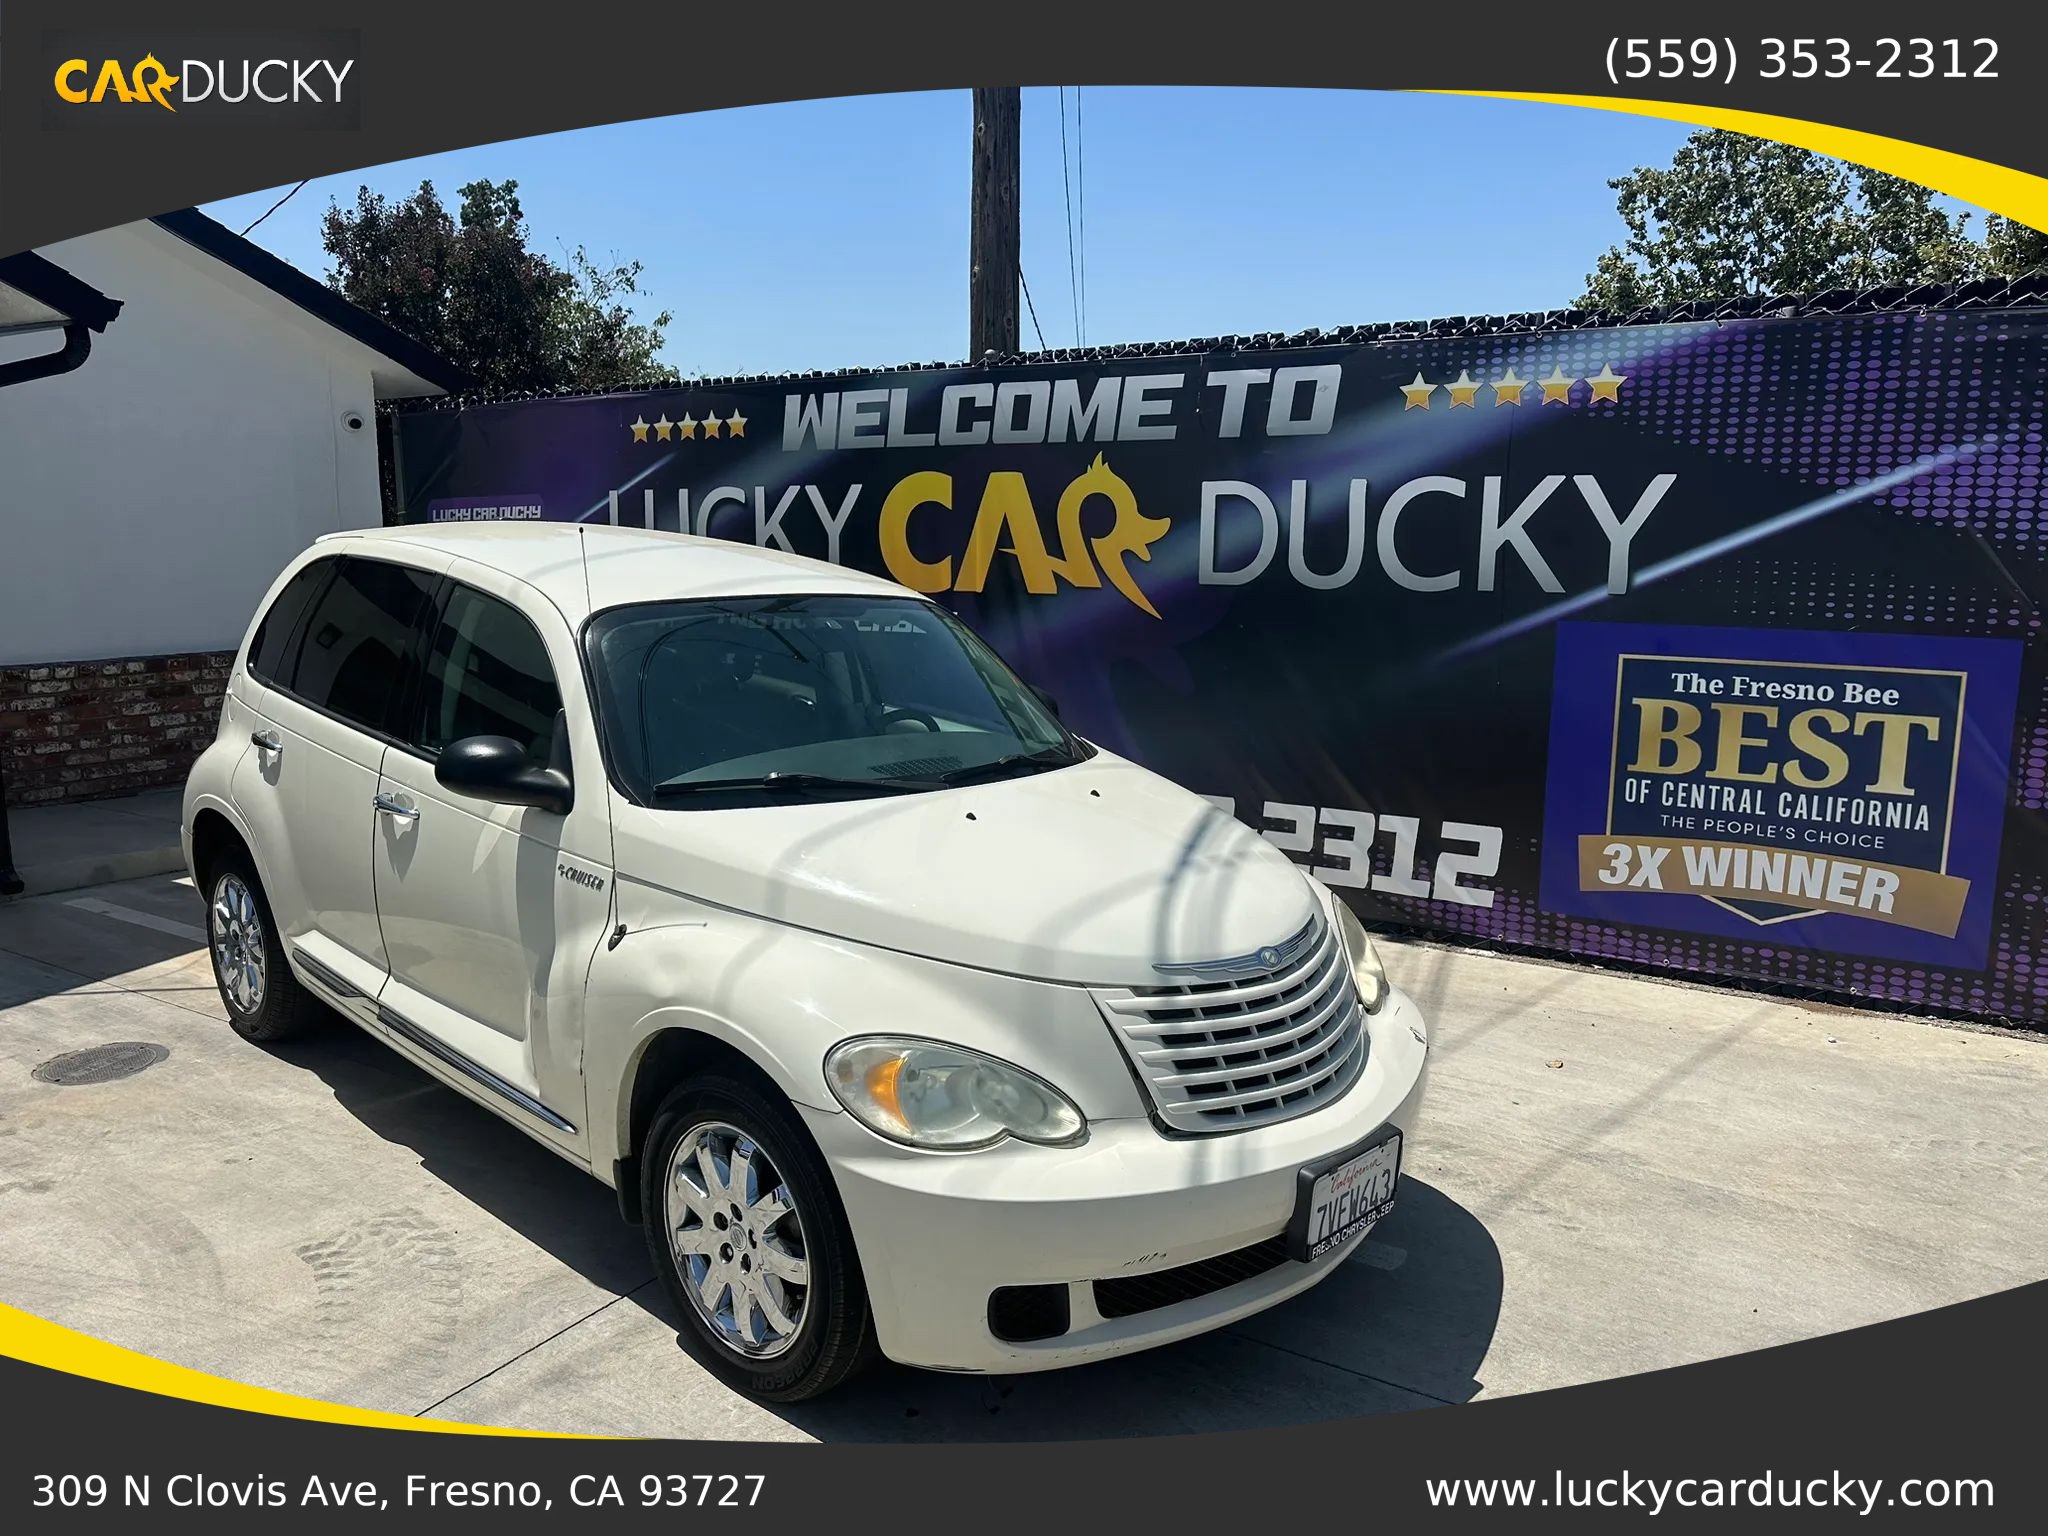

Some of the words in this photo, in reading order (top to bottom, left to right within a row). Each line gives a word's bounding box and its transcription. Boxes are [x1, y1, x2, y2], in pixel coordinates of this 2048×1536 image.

[782, 373, 1185, 452] WELCOME
[1207, 364, 1342, 438] TO
[432, 508, 471, 522] LUCKY
[472, 507, 498, 521] CAR
[879, 451, 1171, 620] CAR
[1199, 474, 1677, 595] DUCKY
[1671, 671, 1724, 696] The
[1731, 675, 1835, 703] Fresno
[1842, 682, 1900, 707] Bee
[1625, 697, 1941, 797] BEST
[1624, 777, 1652, 804] OF
[1661, 780, 1767, 816] CENTRAL
[1777, 791, 1930, 832] CALIFORNIA
[1660, 814, 1696, 831] THE
[1703, 817, 1796, 840] PEOPLE'S
[1803, 828, 1886, 850] CHOICE
[1196, 793, 1503, 908] 2312
[565, 866, 605, 892] CRUISER
[1597, 842, 1672, 890] 3X
[1681, 845, 1901, 915] WINNER
[1330, 1158, 1384, 1194] California
[1316, 1168, 1391, 1242] 7VFW643
[1341, 1210, 1377, 1241] CHRYSLER
